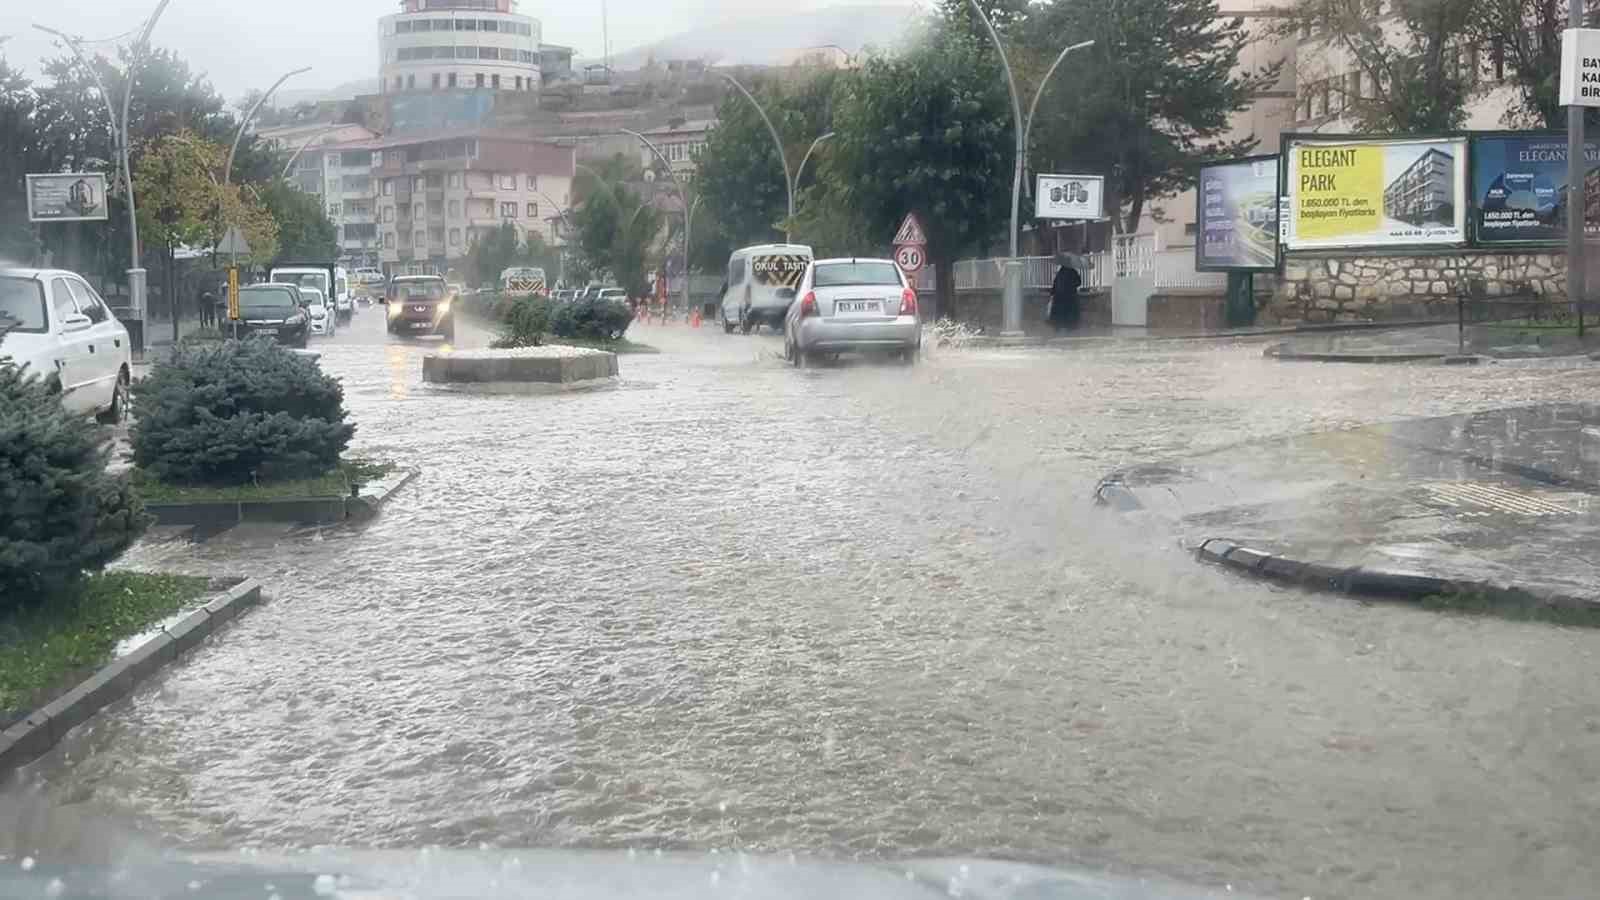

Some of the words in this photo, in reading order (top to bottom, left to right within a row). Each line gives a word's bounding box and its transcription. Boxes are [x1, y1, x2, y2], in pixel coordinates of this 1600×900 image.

[1301, 149, 1357, 168] ELEGANT
[1520, 151, 1568, 161] ELEGAN
[1300, 174, 1336, 192] PARK
[901, 251, 919, 265] 30
[754, 262, 778, 271] OKUL
